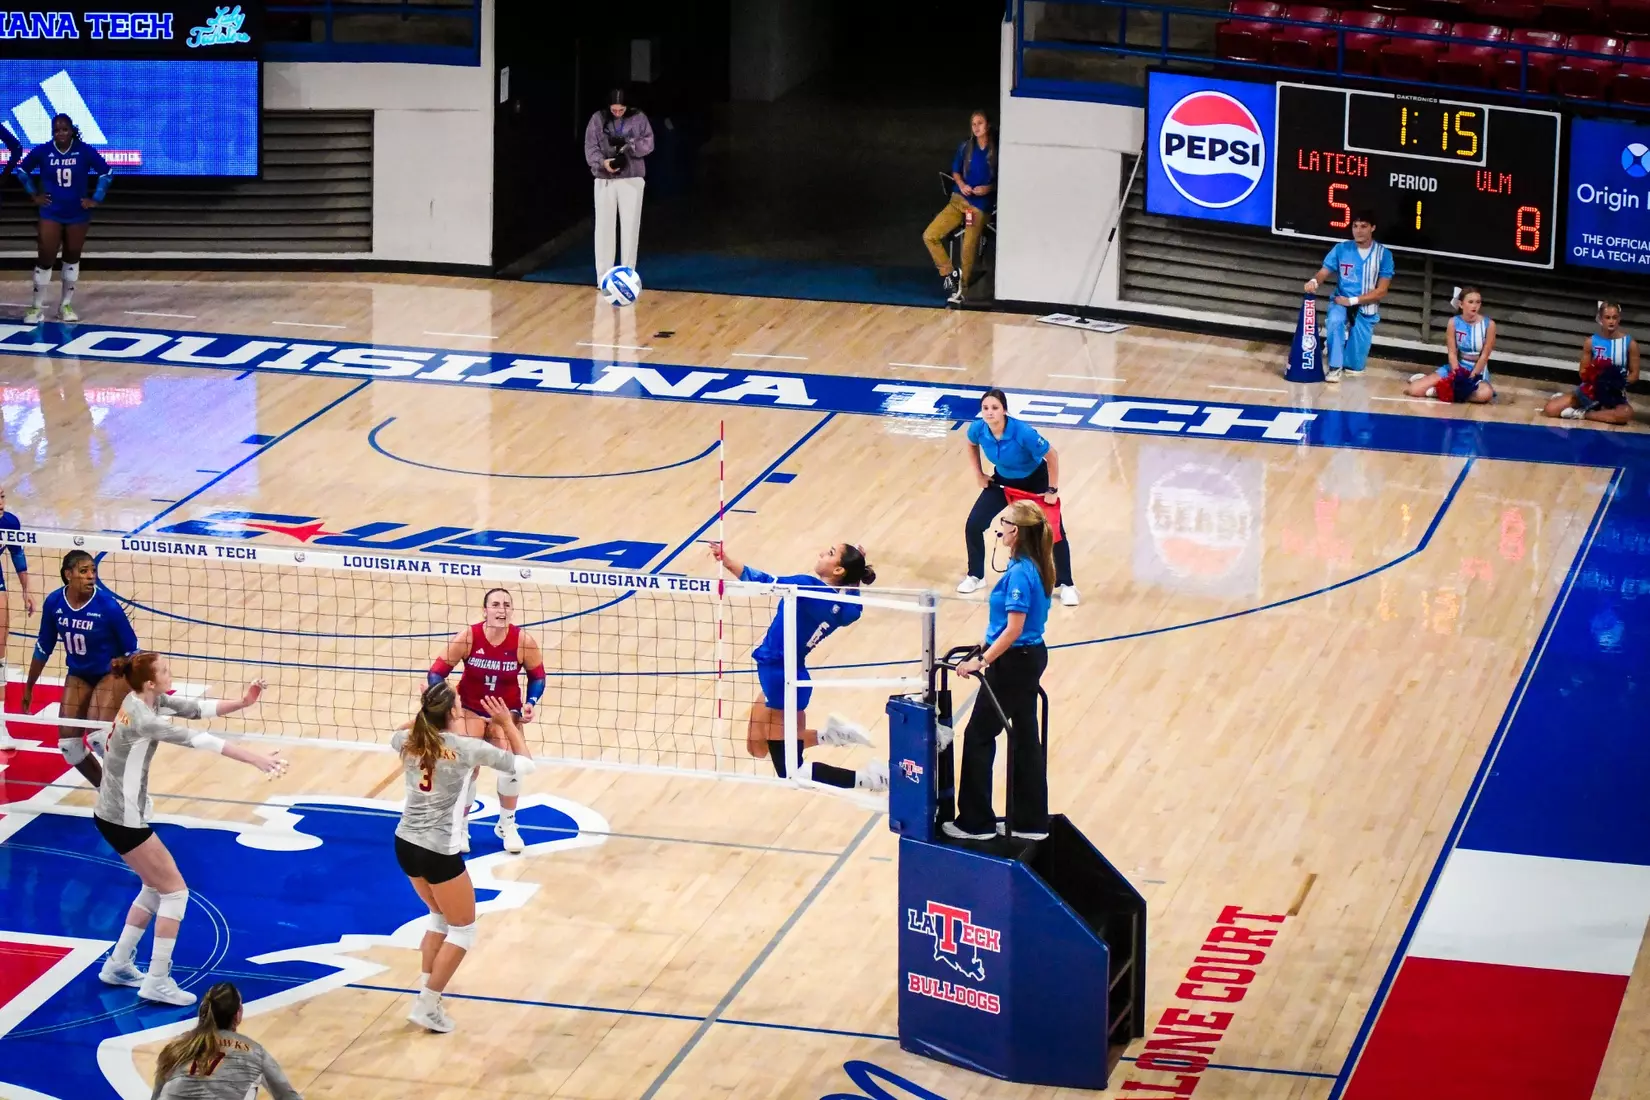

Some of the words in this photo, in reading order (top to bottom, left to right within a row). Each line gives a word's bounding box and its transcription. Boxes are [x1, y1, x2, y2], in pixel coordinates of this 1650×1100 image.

[84, 12, 174, 40] TECH
[206, 4, 246, 32] Lady
[1400, 107, 1478, 156] 1:15
[50, 158, 59, 166] LA
[61, 157, 77, 166] TECH
[1165, 132, 1260, 167] PEPSI
[56, 168, 72, 187] 19
[1389, 172, 1438, 193] PERIOD
[1475, 170, 1512, 194] ULM
[1328, 183, 1351, 228] 5
[1576, 183, 1640, 212] Origin
[1415, 200, 1422, 230] 1
[1515, 205, 1541, 251] 8
[1582, 233, 1604, 246] THE
[1573, 246, 1589, 257] OF
[1591, 249, 1605, 260] LA
[1607, 251, 1636, 263] TECH
[1303, 300, 1316, 336] TECH
[0, 323, 818, 406] LOUISIANA
[871, 383, 1318, 441] TECH
[121, 540, 208, 557] LOUISIANA
[215, 546, 257, 560] TECH
[343, 556, 432, 573] LOUISIANA
[439, 562, 482, 577] TECH
[569, 572, 660, 590] LOUISIANA
[668, 578, 711, 592] TECH
[72, 618, 93, 631] TECH
[65, 631, 87, 655] 10
[467, 656, 501, 671] LOUISIANA
[484, 674, 497, 691] 4
[419, 761, 434, 792] 3
[908, 908, 937, 936] LA
[907, 972, 1001, 1014] BULLDOGS
[1113, 1007, 1235, 1100] LONE
[1174, 904, 1287, 1003] COURT
